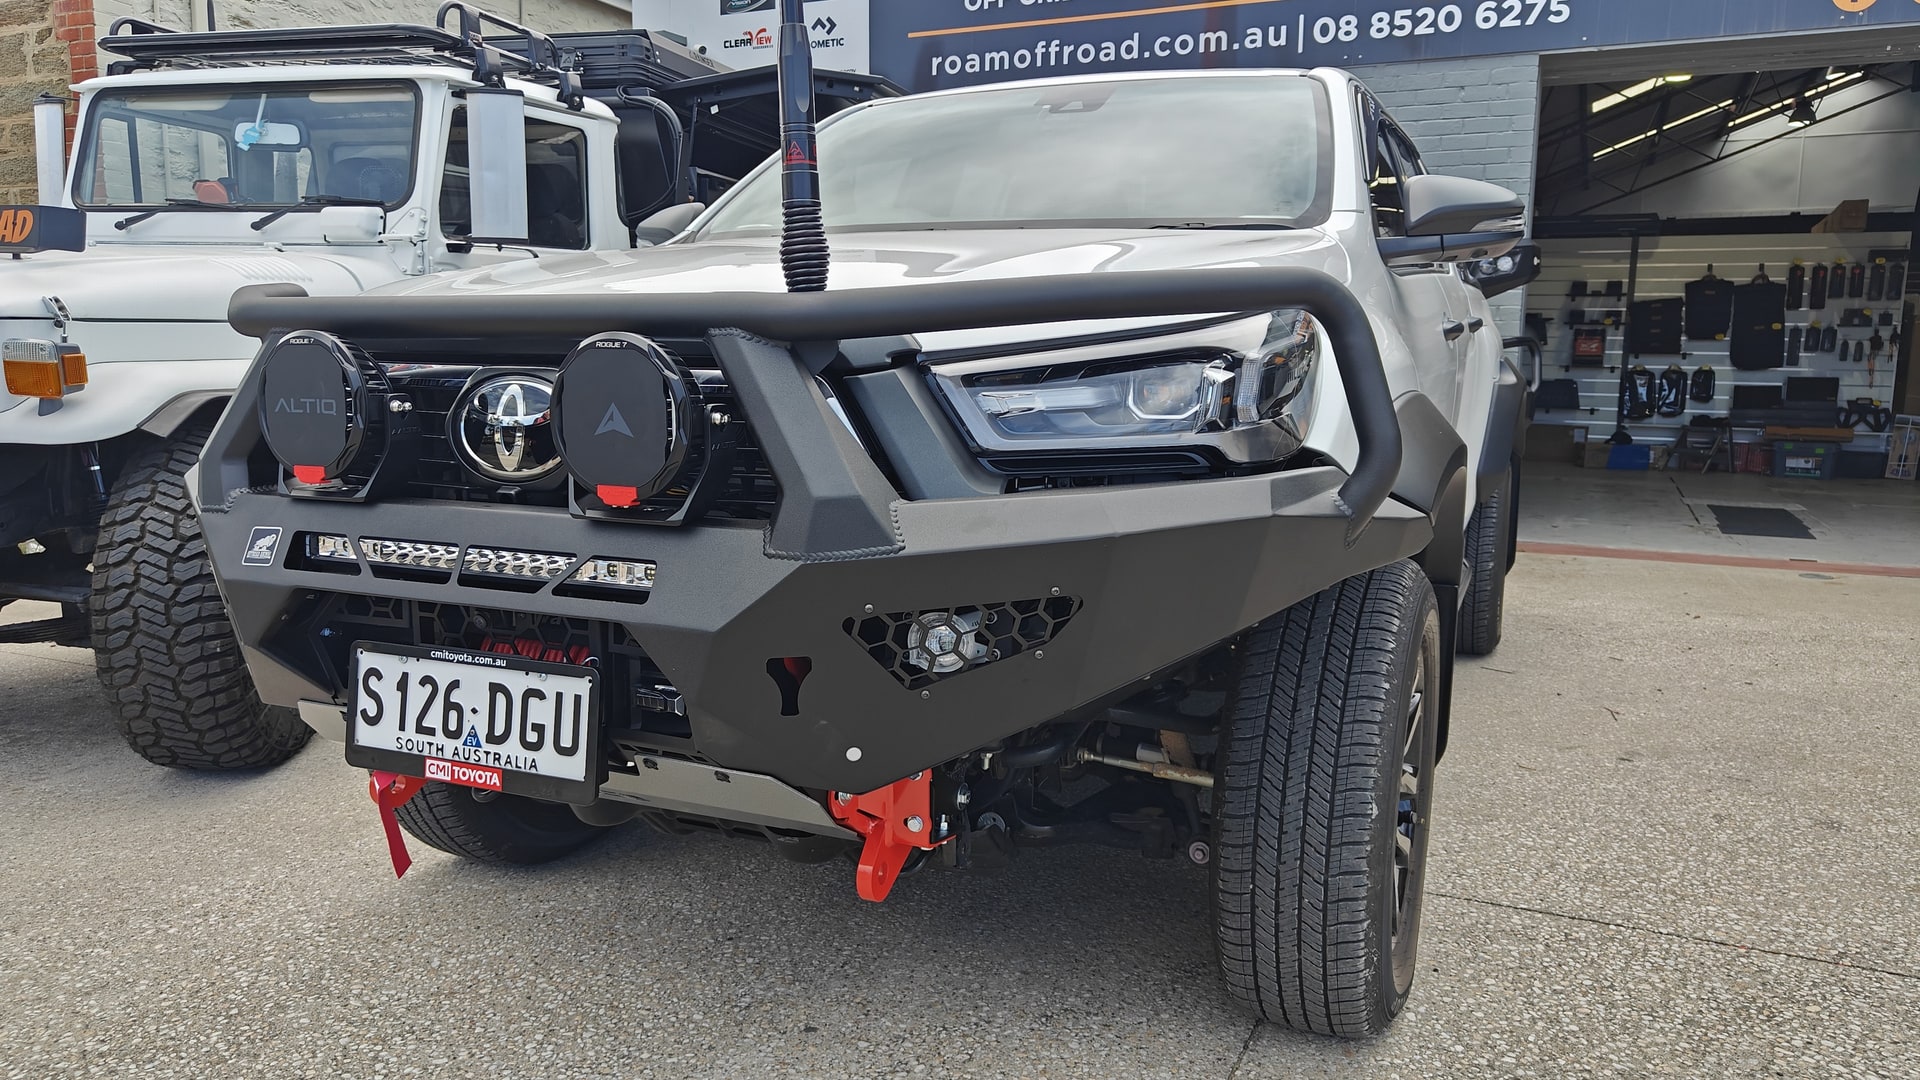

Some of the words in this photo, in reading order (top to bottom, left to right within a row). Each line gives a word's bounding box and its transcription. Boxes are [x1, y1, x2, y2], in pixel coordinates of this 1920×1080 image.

[810, 37, 844, 49] OMETIC
[931, 25, 1287, 76] roamoffroad.com.au
[1313, 15, 1359, 44] 08
[1369, 5, 1463, 39] 8520
[1475, 0, 1570, 29] 6275
[275, 398, 337, 416] ALTIQ
[430, 650, 507, 667] cmitoyota.com.au
[466, 736, 478, 746] EV
[395, 736, 444, 757] SOUTH
[452, 745, 538, 772] AUSTRALIA
[428, 762, 450, 778] CMI
[452, 765, 500, 787] TOYOTA
